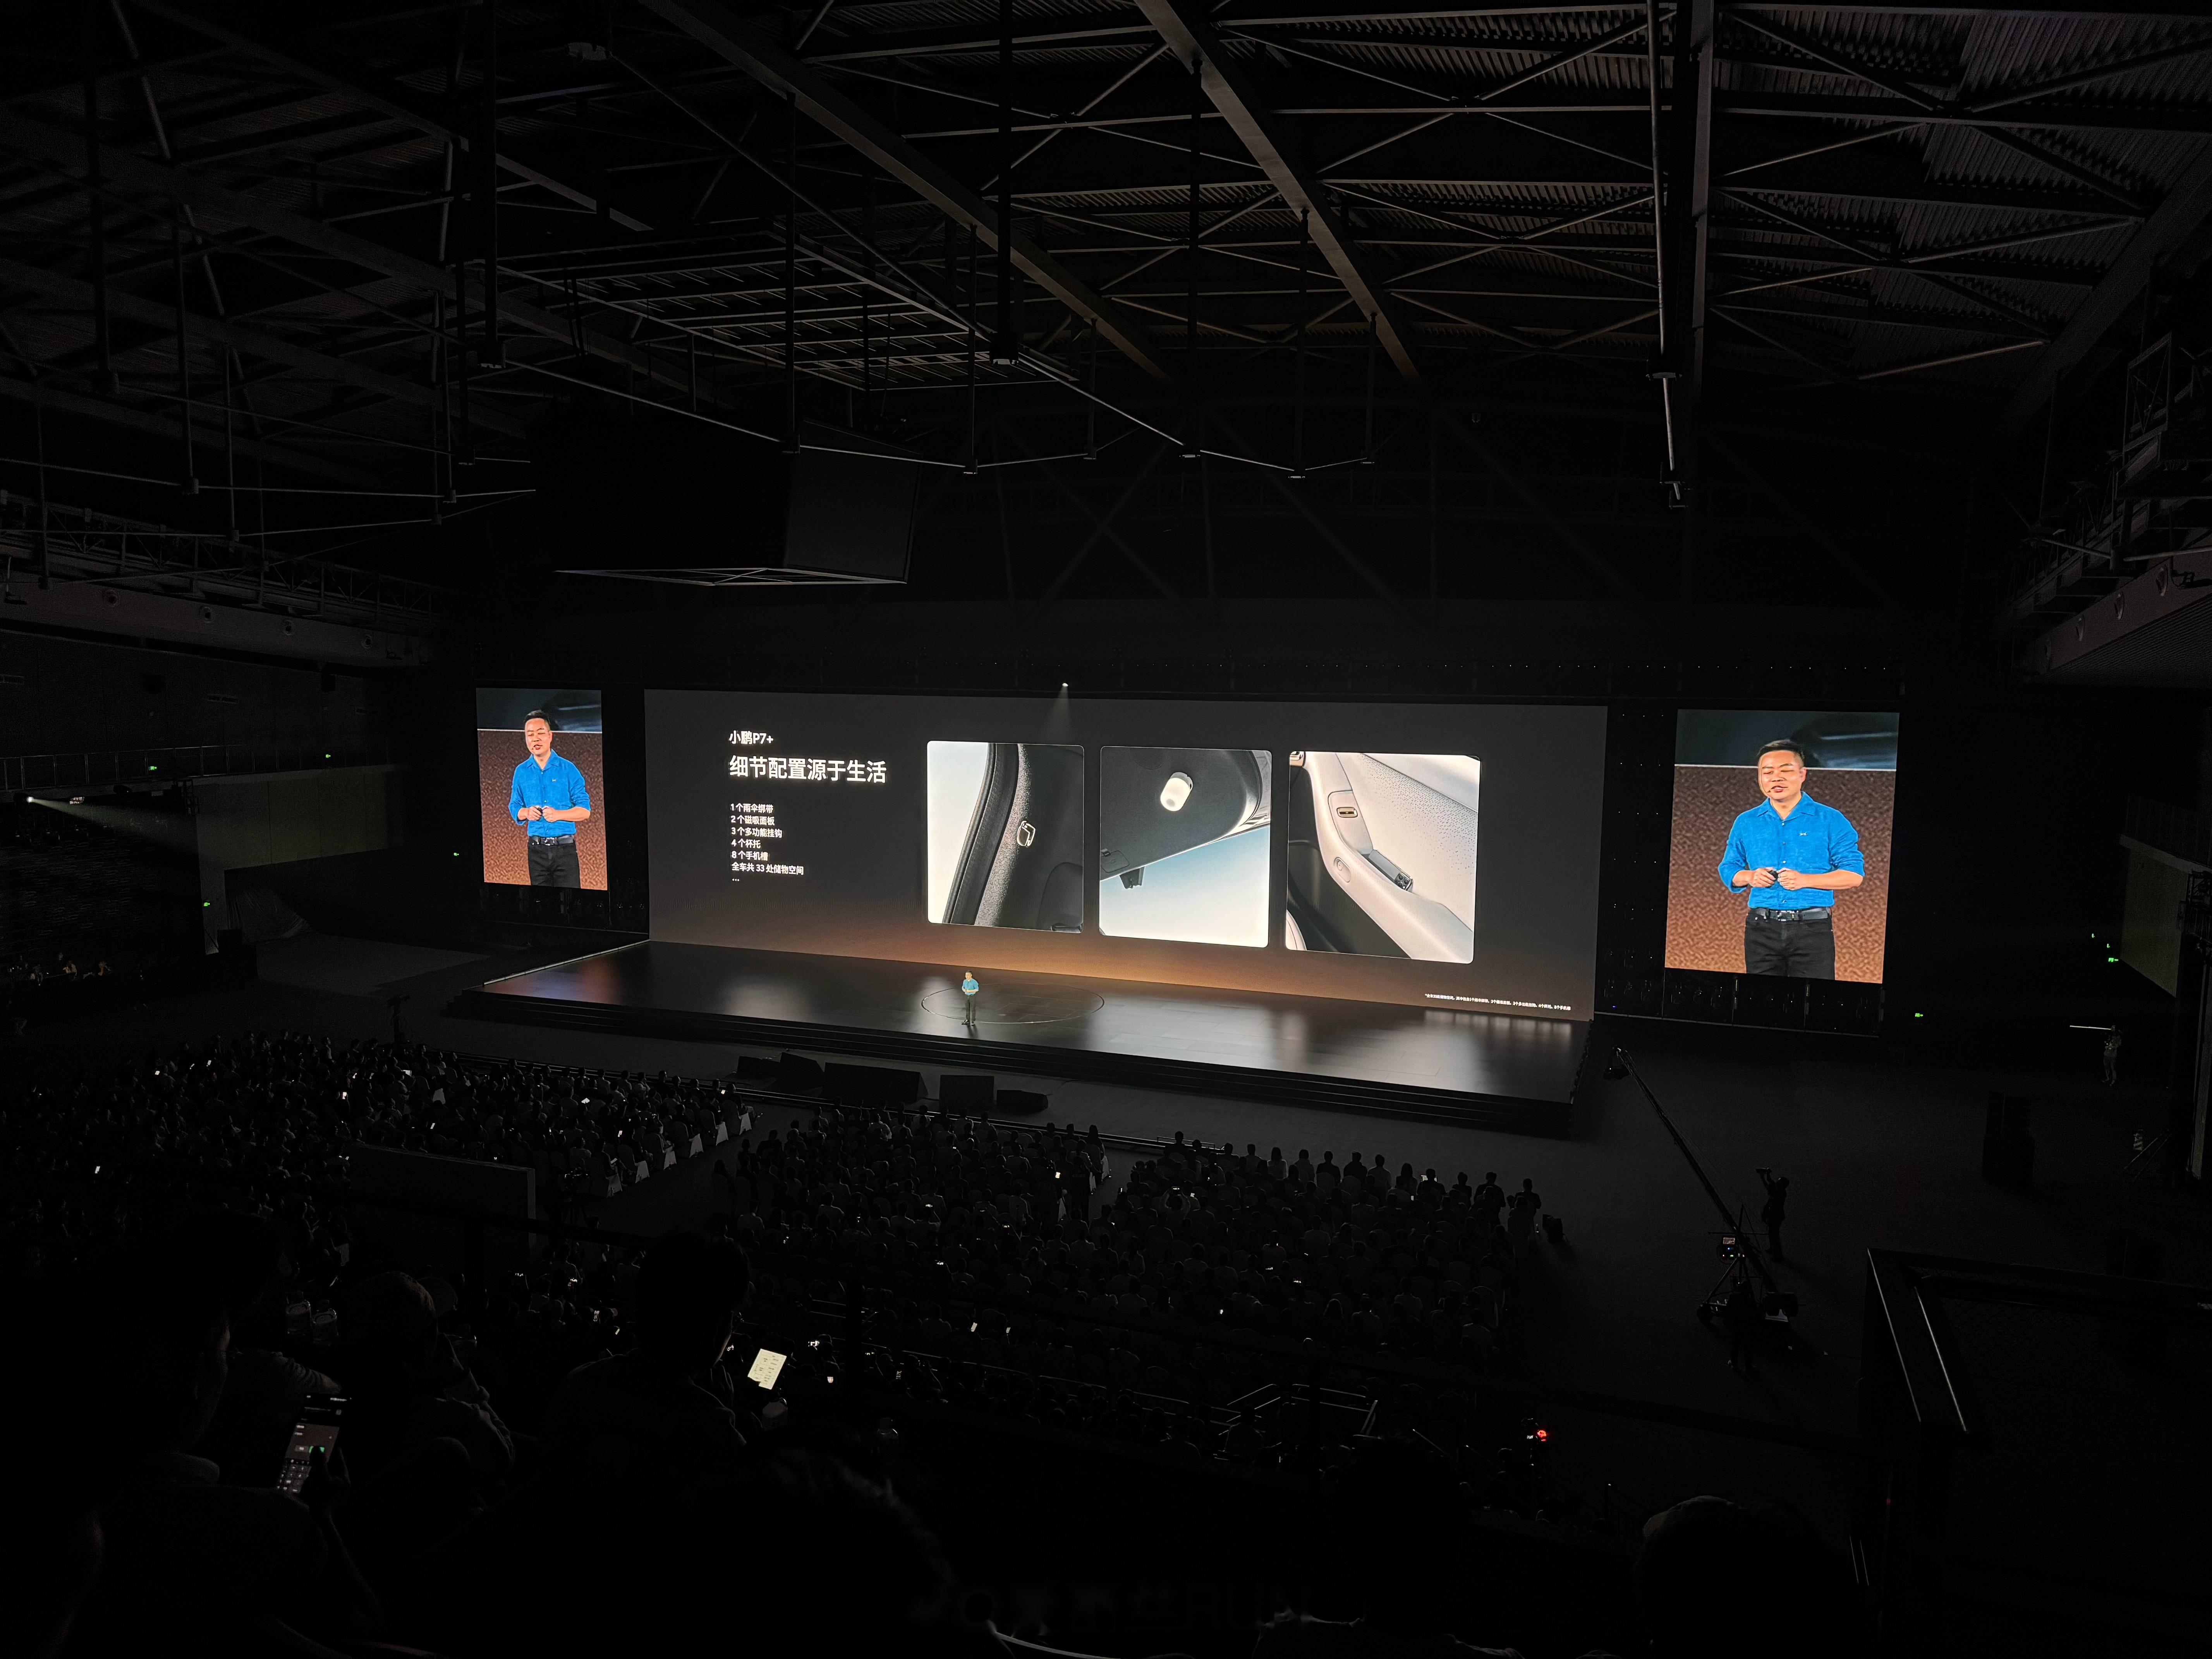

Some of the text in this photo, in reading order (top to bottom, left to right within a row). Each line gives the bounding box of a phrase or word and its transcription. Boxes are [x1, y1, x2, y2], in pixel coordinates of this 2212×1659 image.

[728, 755, 886, 783] 细节配置源于生活
